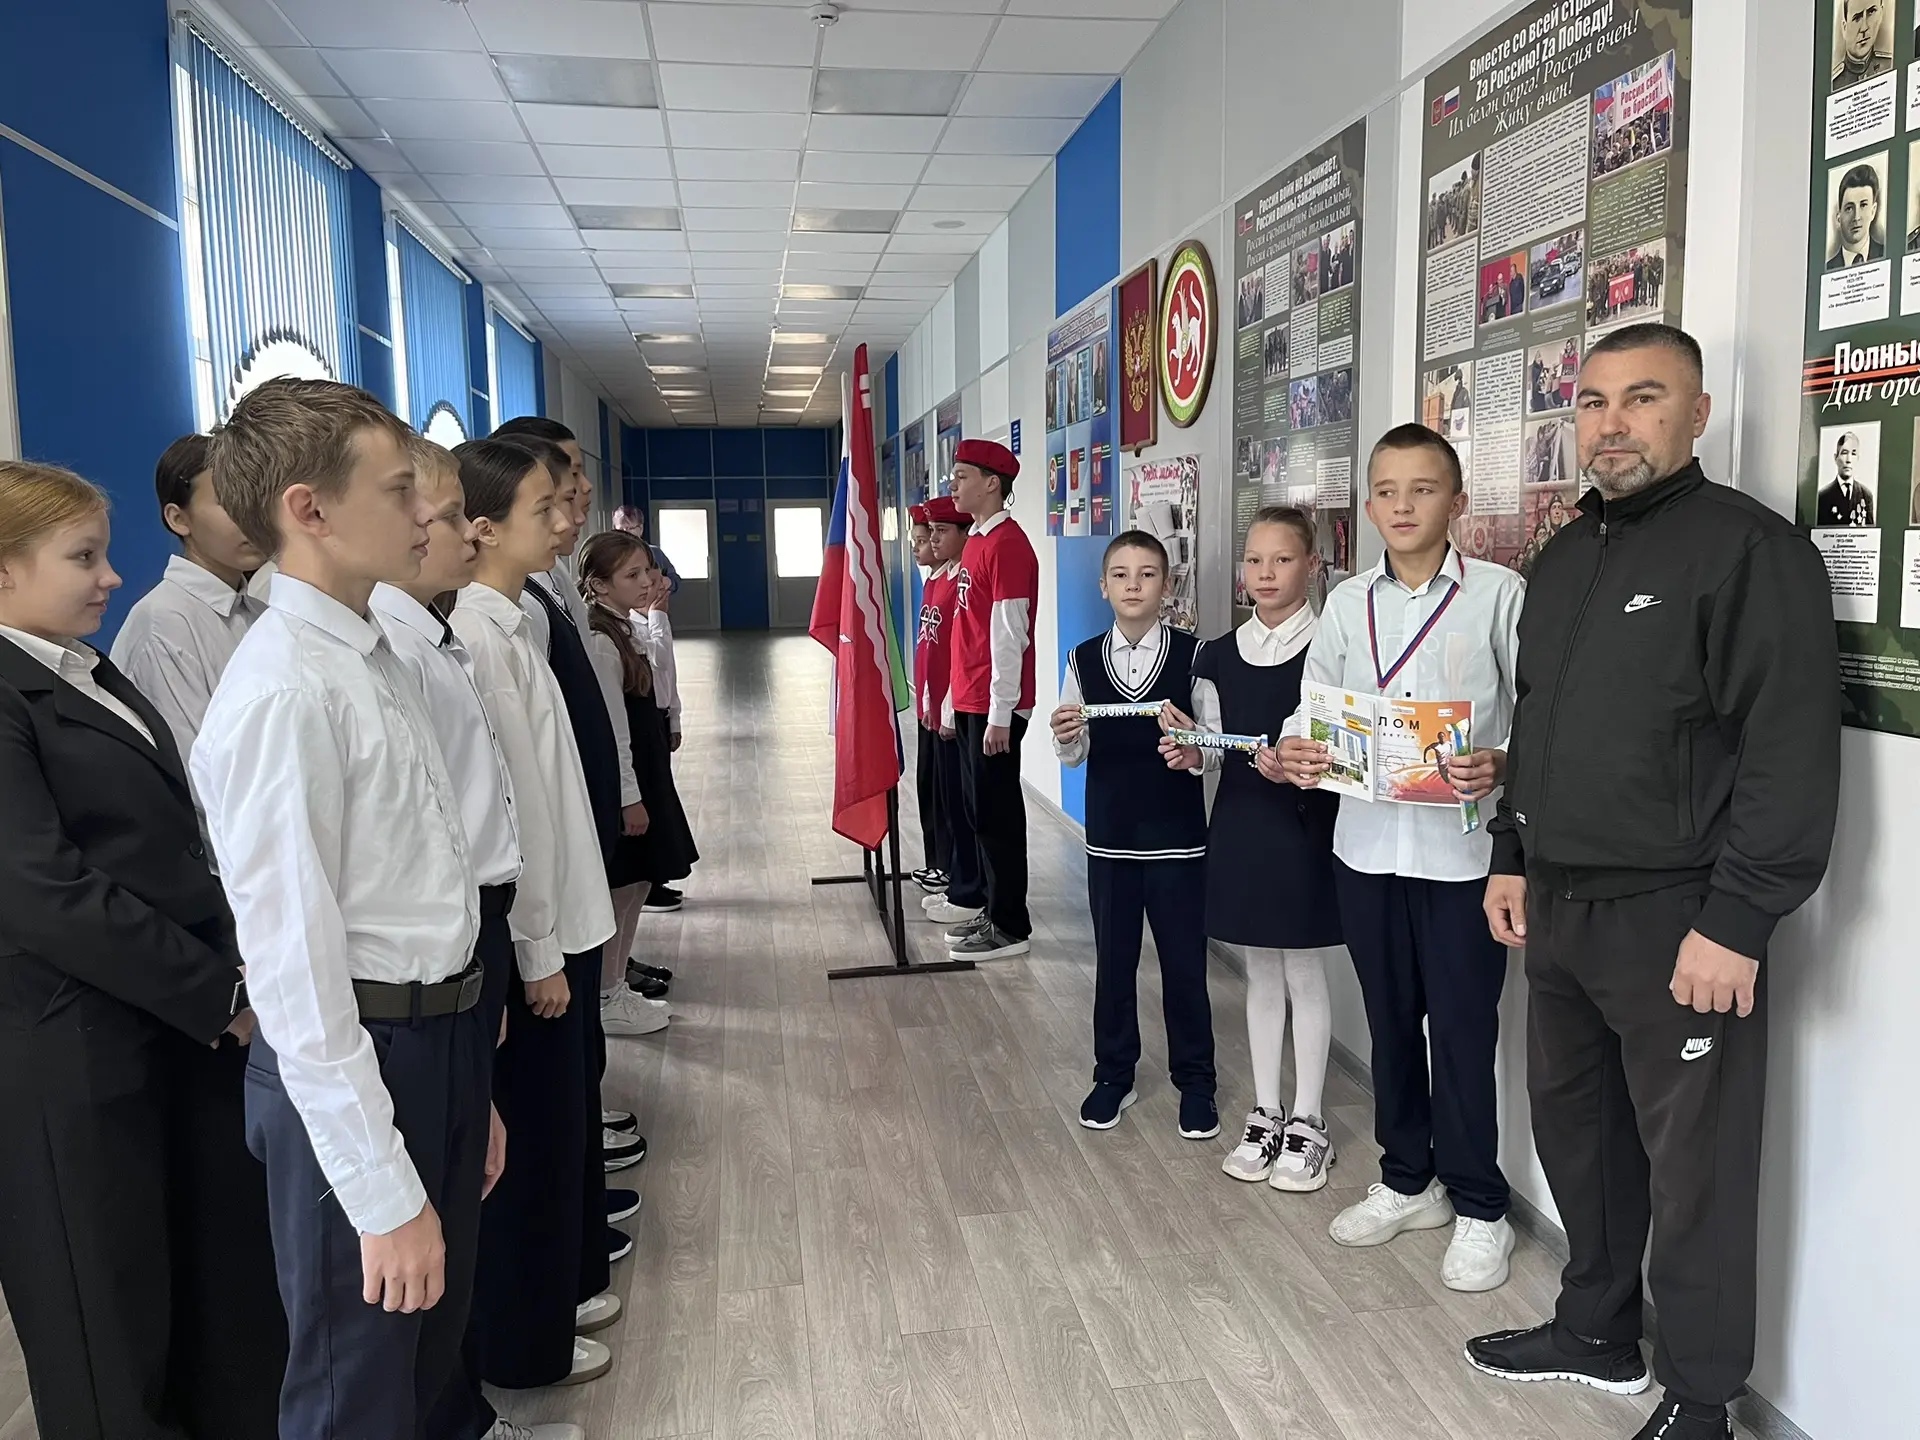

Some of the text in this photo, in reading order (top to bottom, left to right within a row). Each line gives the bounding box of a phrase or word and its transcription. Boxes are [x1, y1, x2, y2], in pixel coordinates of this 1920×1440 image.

[1469, 39, 1511, 81] Вместе
[1513, 30, 1526, 53] со
[1528, 2, 1559, 43] всей
[1489, 42, 1540, 94] Россию!
[1558, 0, 1613, 53] Победу!
[1466, 97, 1499, 128] белән
[1502, 67, 1540, 108] бергә!
[1543, 42, 1592, 84] Россия
[1596, 8, 1640, 53] өчен!
[1536, 73, 1574, 112] өчен!
[1621, 82, 1645, 106] Россия
[1834, 339, 1920, 376] Полны
[1821, 377, 1874, 414] Дан
[1091, 702, 1138, 717] BOUNTY
[1188, 735, 1235, 749] BOUNTY
[1685, 1036, 1713, 1052] NIKE
